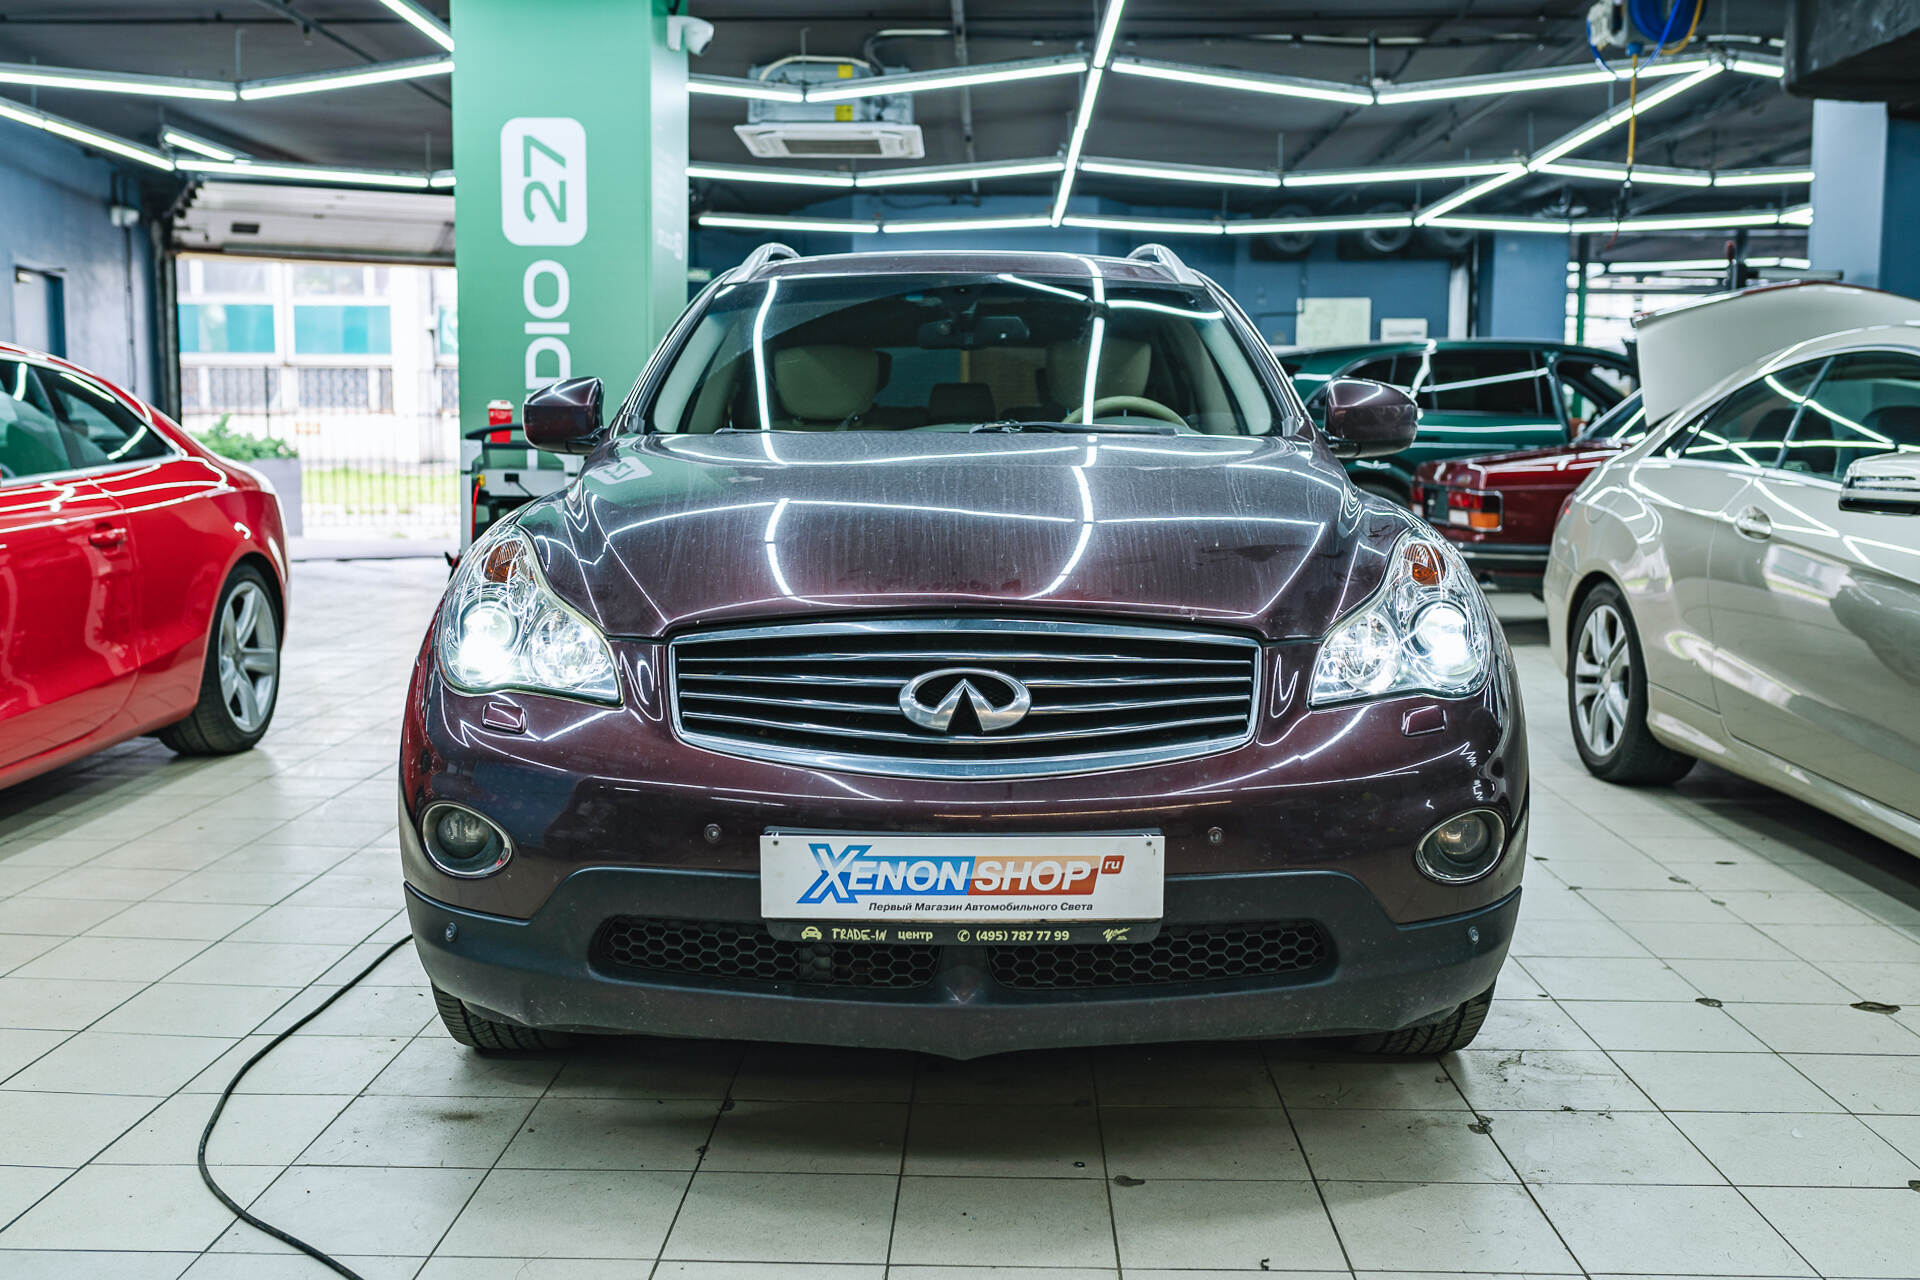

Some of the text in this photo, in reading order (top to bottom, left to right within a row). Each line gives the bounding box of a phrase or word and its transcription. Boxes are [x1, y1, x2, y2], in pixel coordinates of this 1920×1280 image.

[522, 134, 571, 400] DIO 27
[1104, 861, 1121, 870] ru
[868, 902, 1093, 912] Первый Магазин Автомобильного Света
[832, 928, 933, 941] TRADE-IN центр
[976, 930, 1070, 942] (495) 787 77 99
